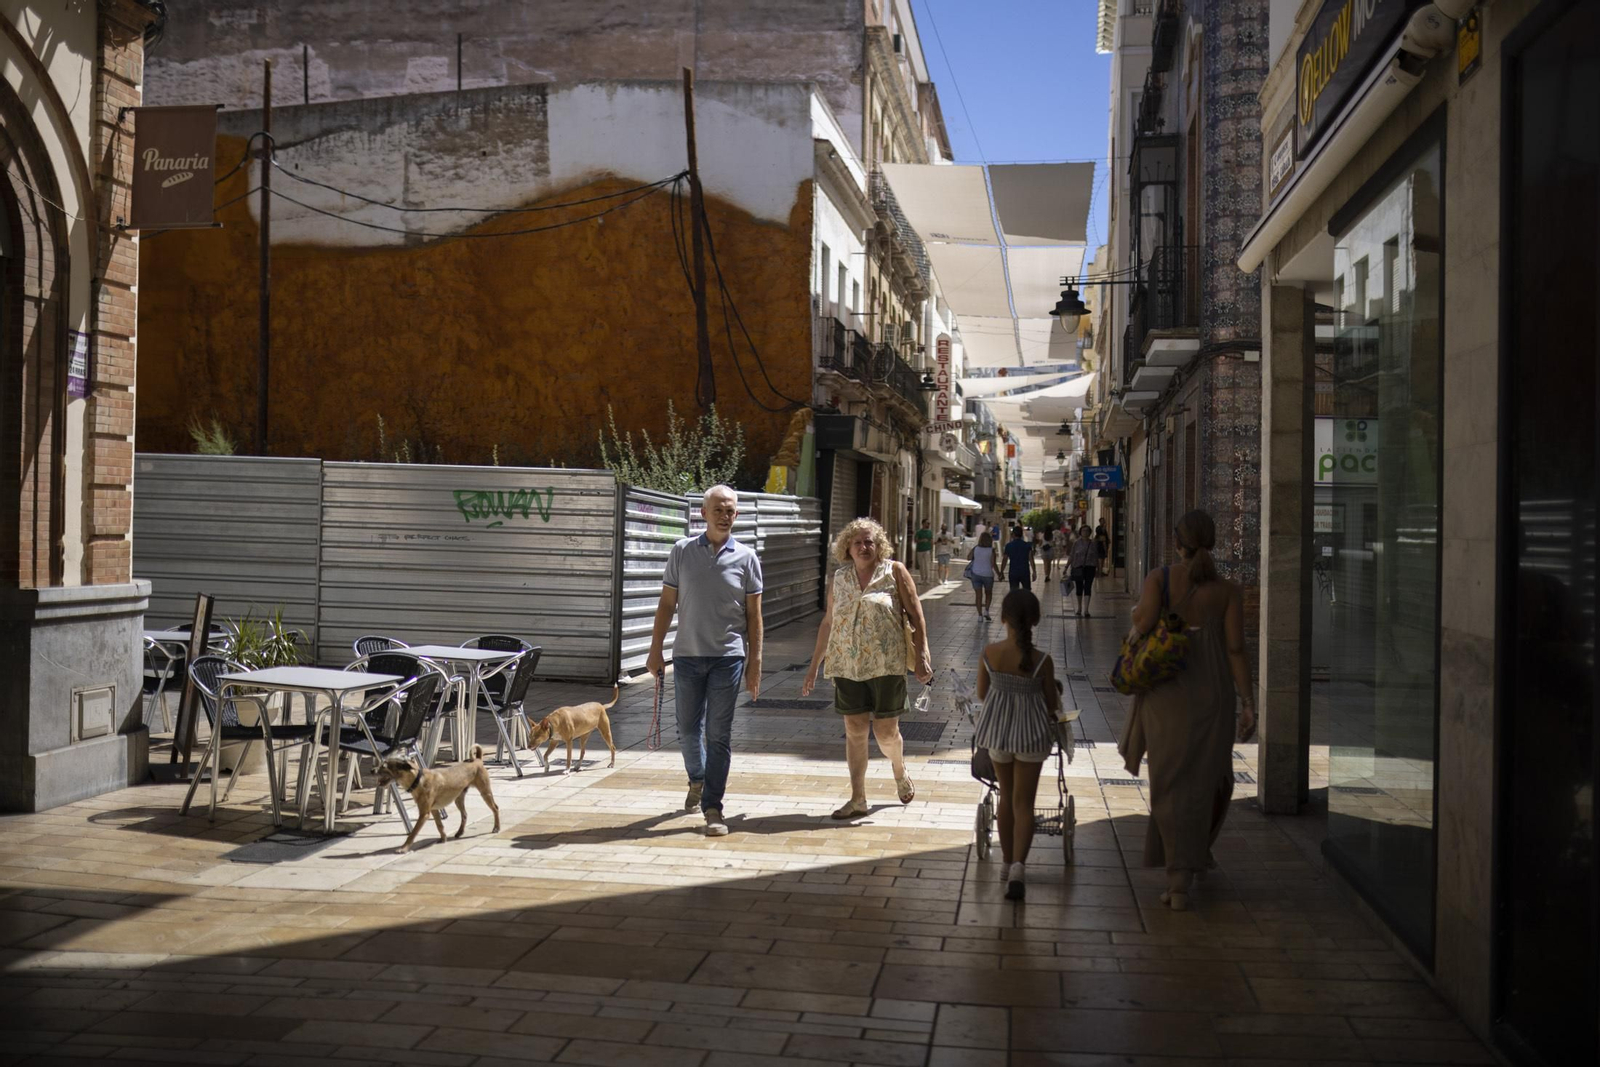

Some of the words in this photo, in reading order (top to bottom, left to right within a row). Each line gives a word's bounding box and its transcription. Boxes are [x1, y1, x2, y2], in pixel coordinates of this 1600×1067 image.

[142, 148, 209, 171] Panaria
[937, 339, 949, 421] RESTAURANTE
[926, 421, 962, 434] CHINO
